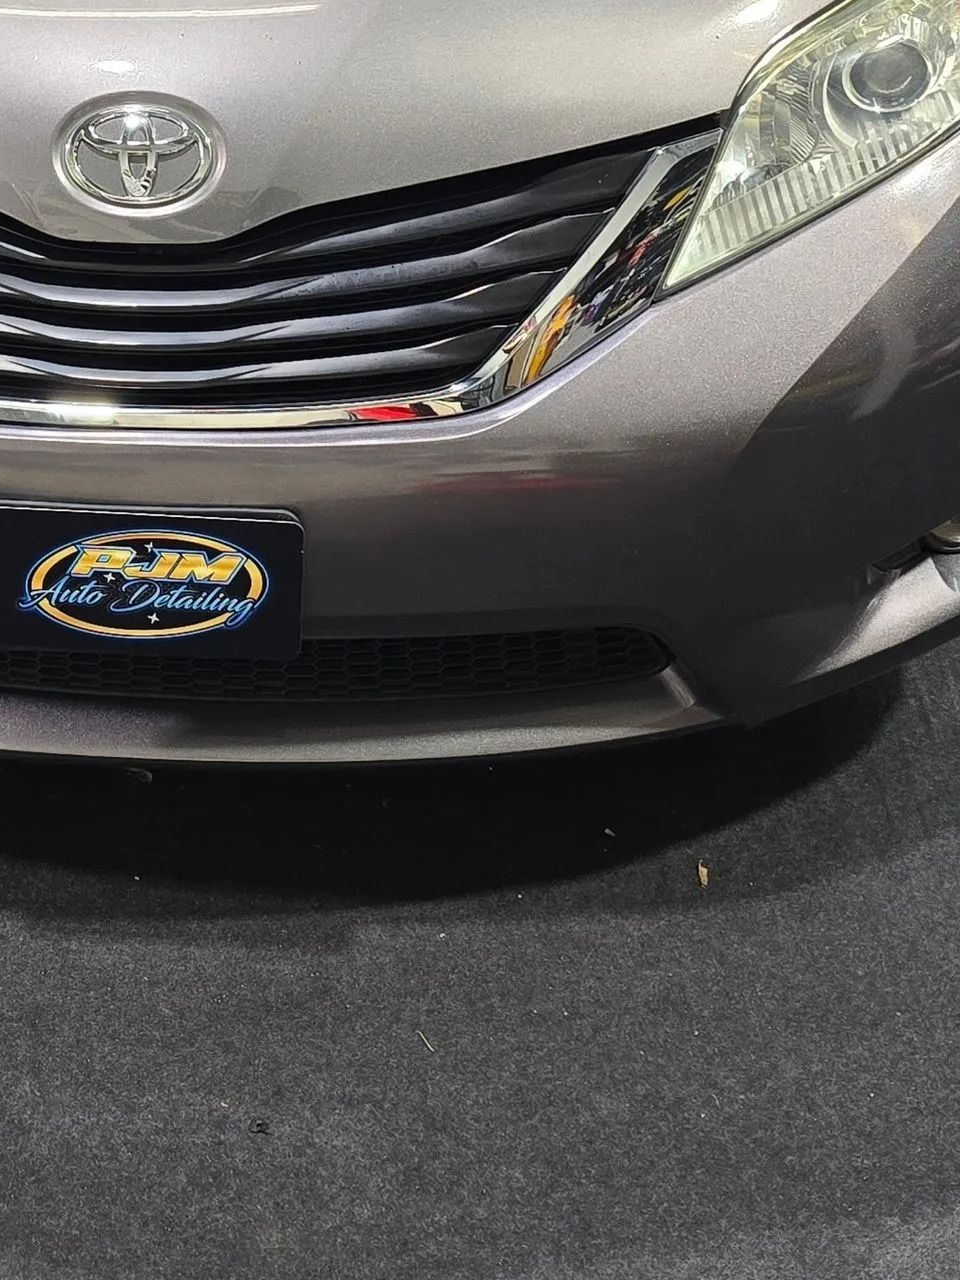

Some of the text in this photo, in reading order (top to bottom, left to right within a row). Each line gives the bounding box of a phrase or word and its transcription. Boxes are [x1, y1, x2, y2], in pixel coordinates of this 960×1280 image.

[68, 545, 246, 585] PJM
[19, 575, 255, 626] Auto Detailing
